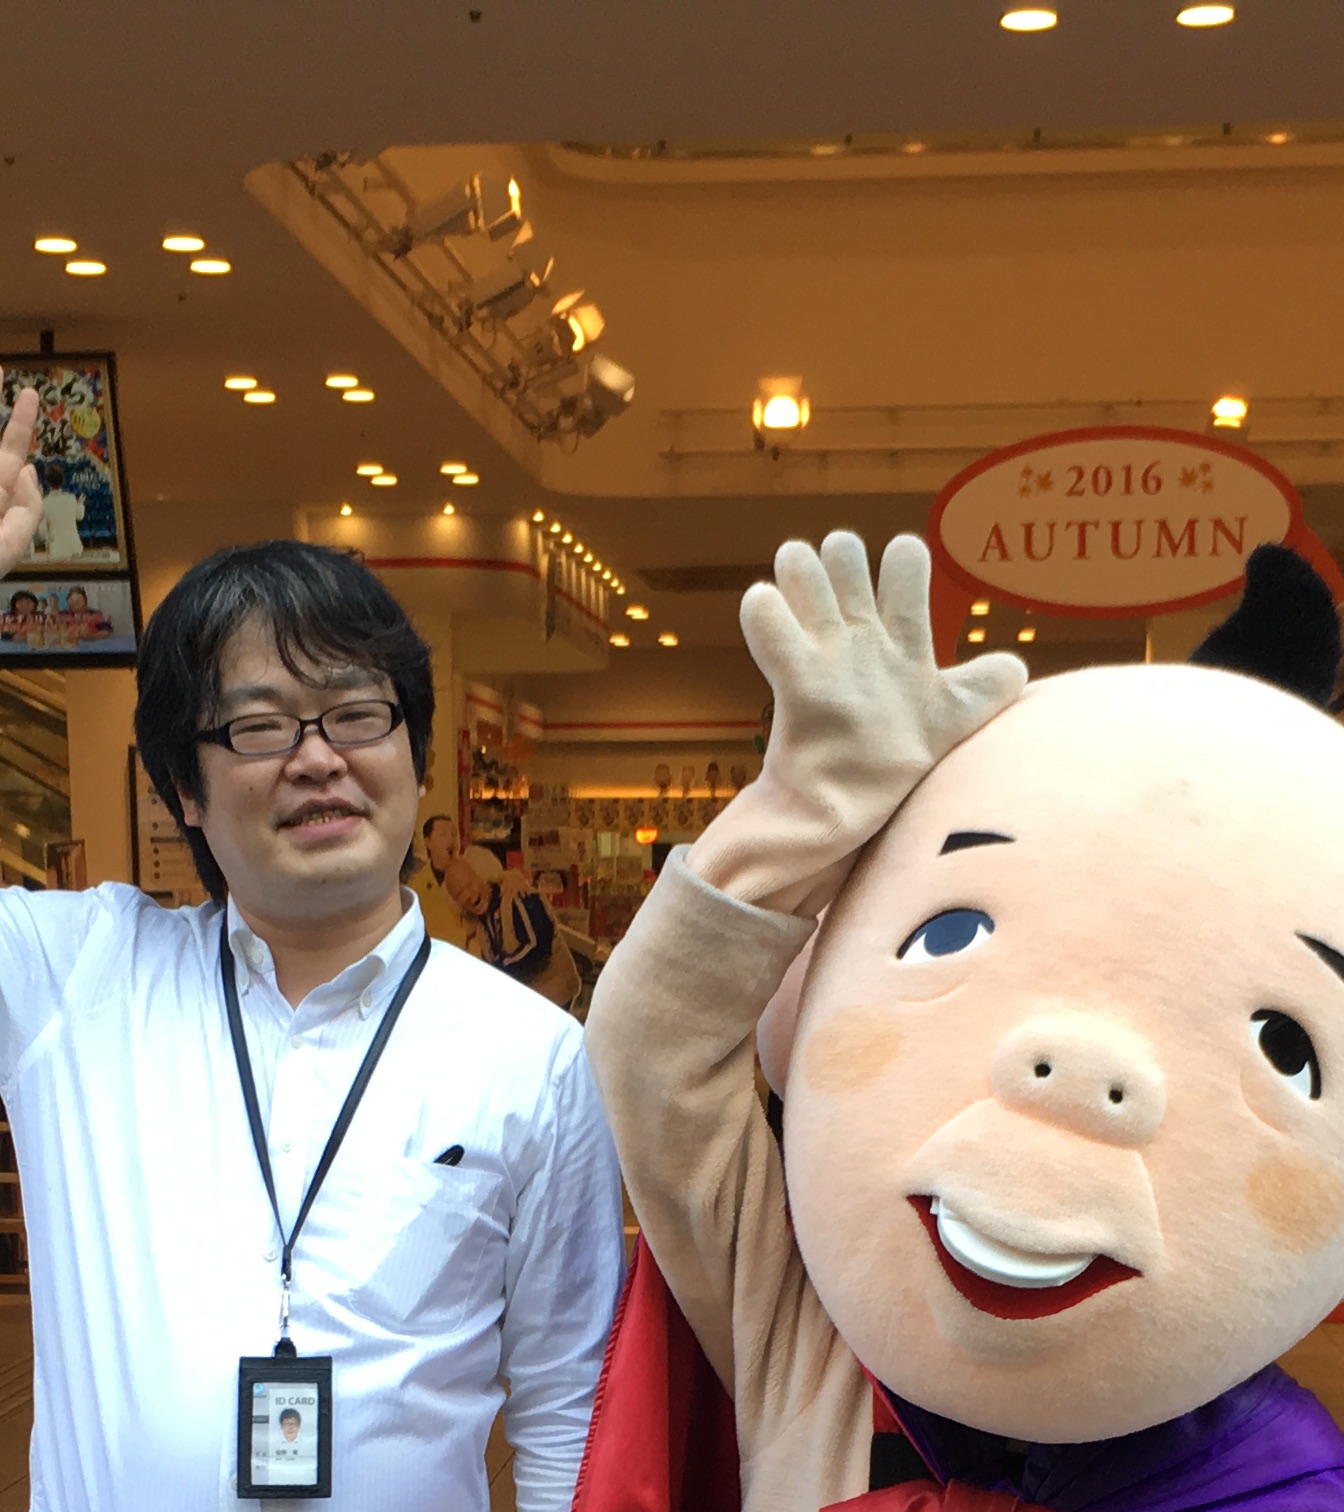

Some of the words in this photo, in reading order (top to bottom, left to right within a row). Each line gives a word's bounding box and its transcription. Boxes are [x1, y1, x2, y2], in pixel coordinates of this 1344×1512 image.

[1064, 460, 1164, 498] 2016
[977, 516, 1248, 564] AUTUMN
[275, 1396, 286, 1406] ID
[288, 1396, 316, 1406] CARD
